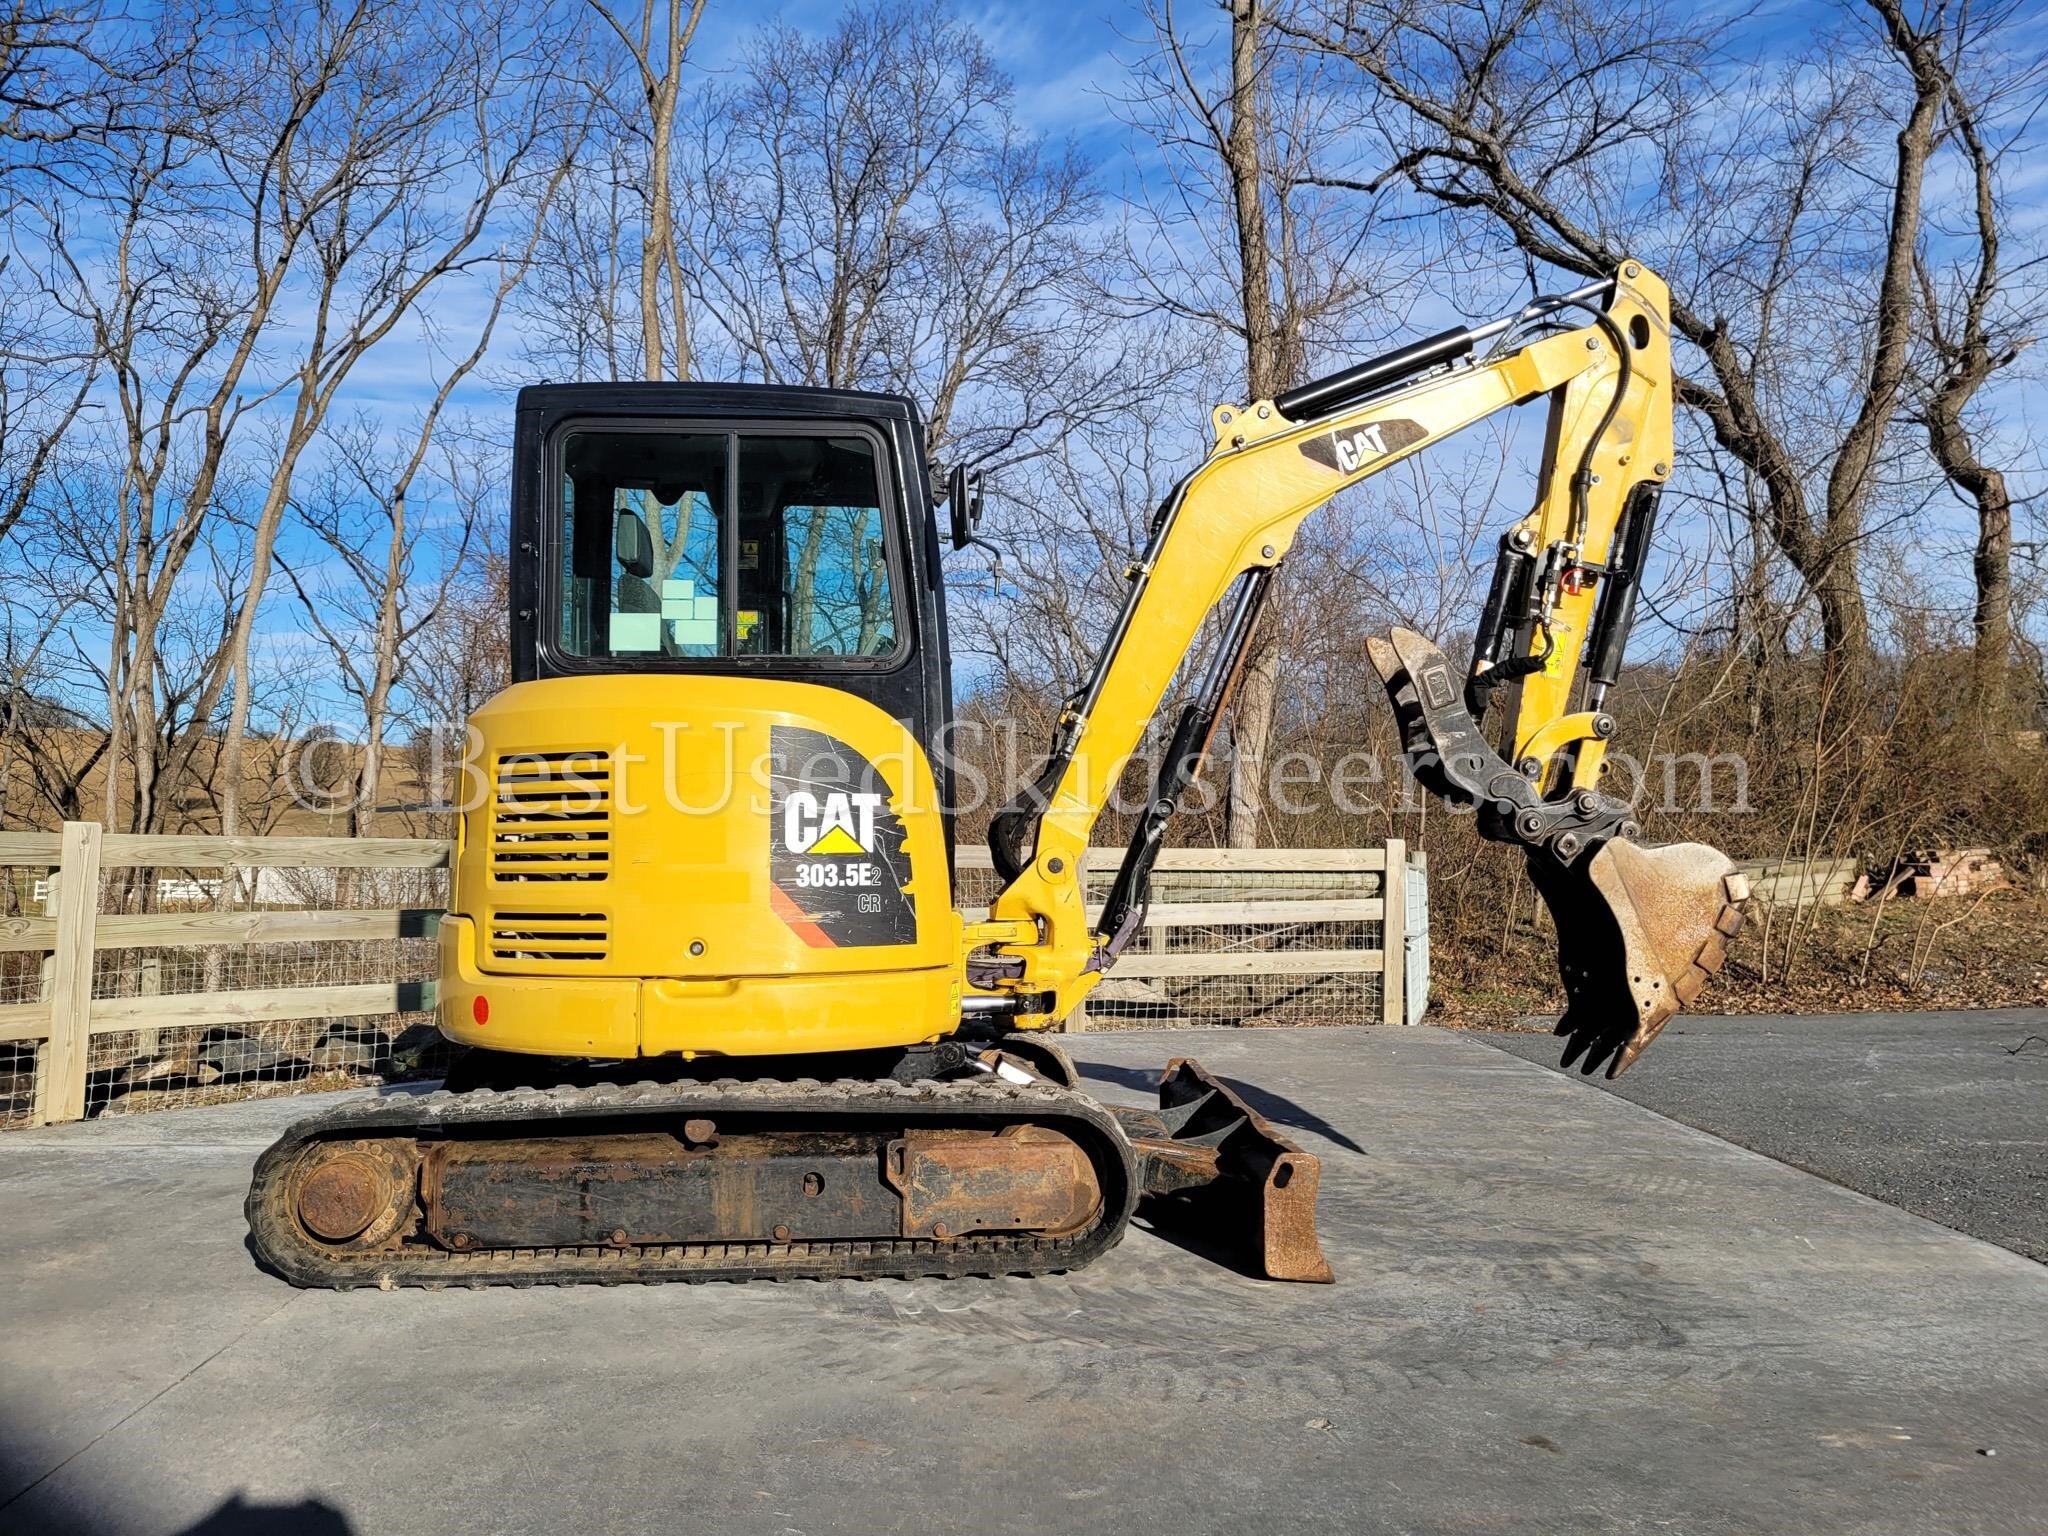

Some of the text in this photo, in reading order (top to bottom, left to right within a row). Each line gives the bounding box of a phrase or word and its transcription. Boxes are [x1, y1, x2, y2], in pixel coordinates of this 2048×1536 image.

[1335, 423, 1388, 472] CAT
[784, 791, 881, 855] CAT
[795, 862, 882, 888] 303.5E2
[857, 893, 882, 914] CR
